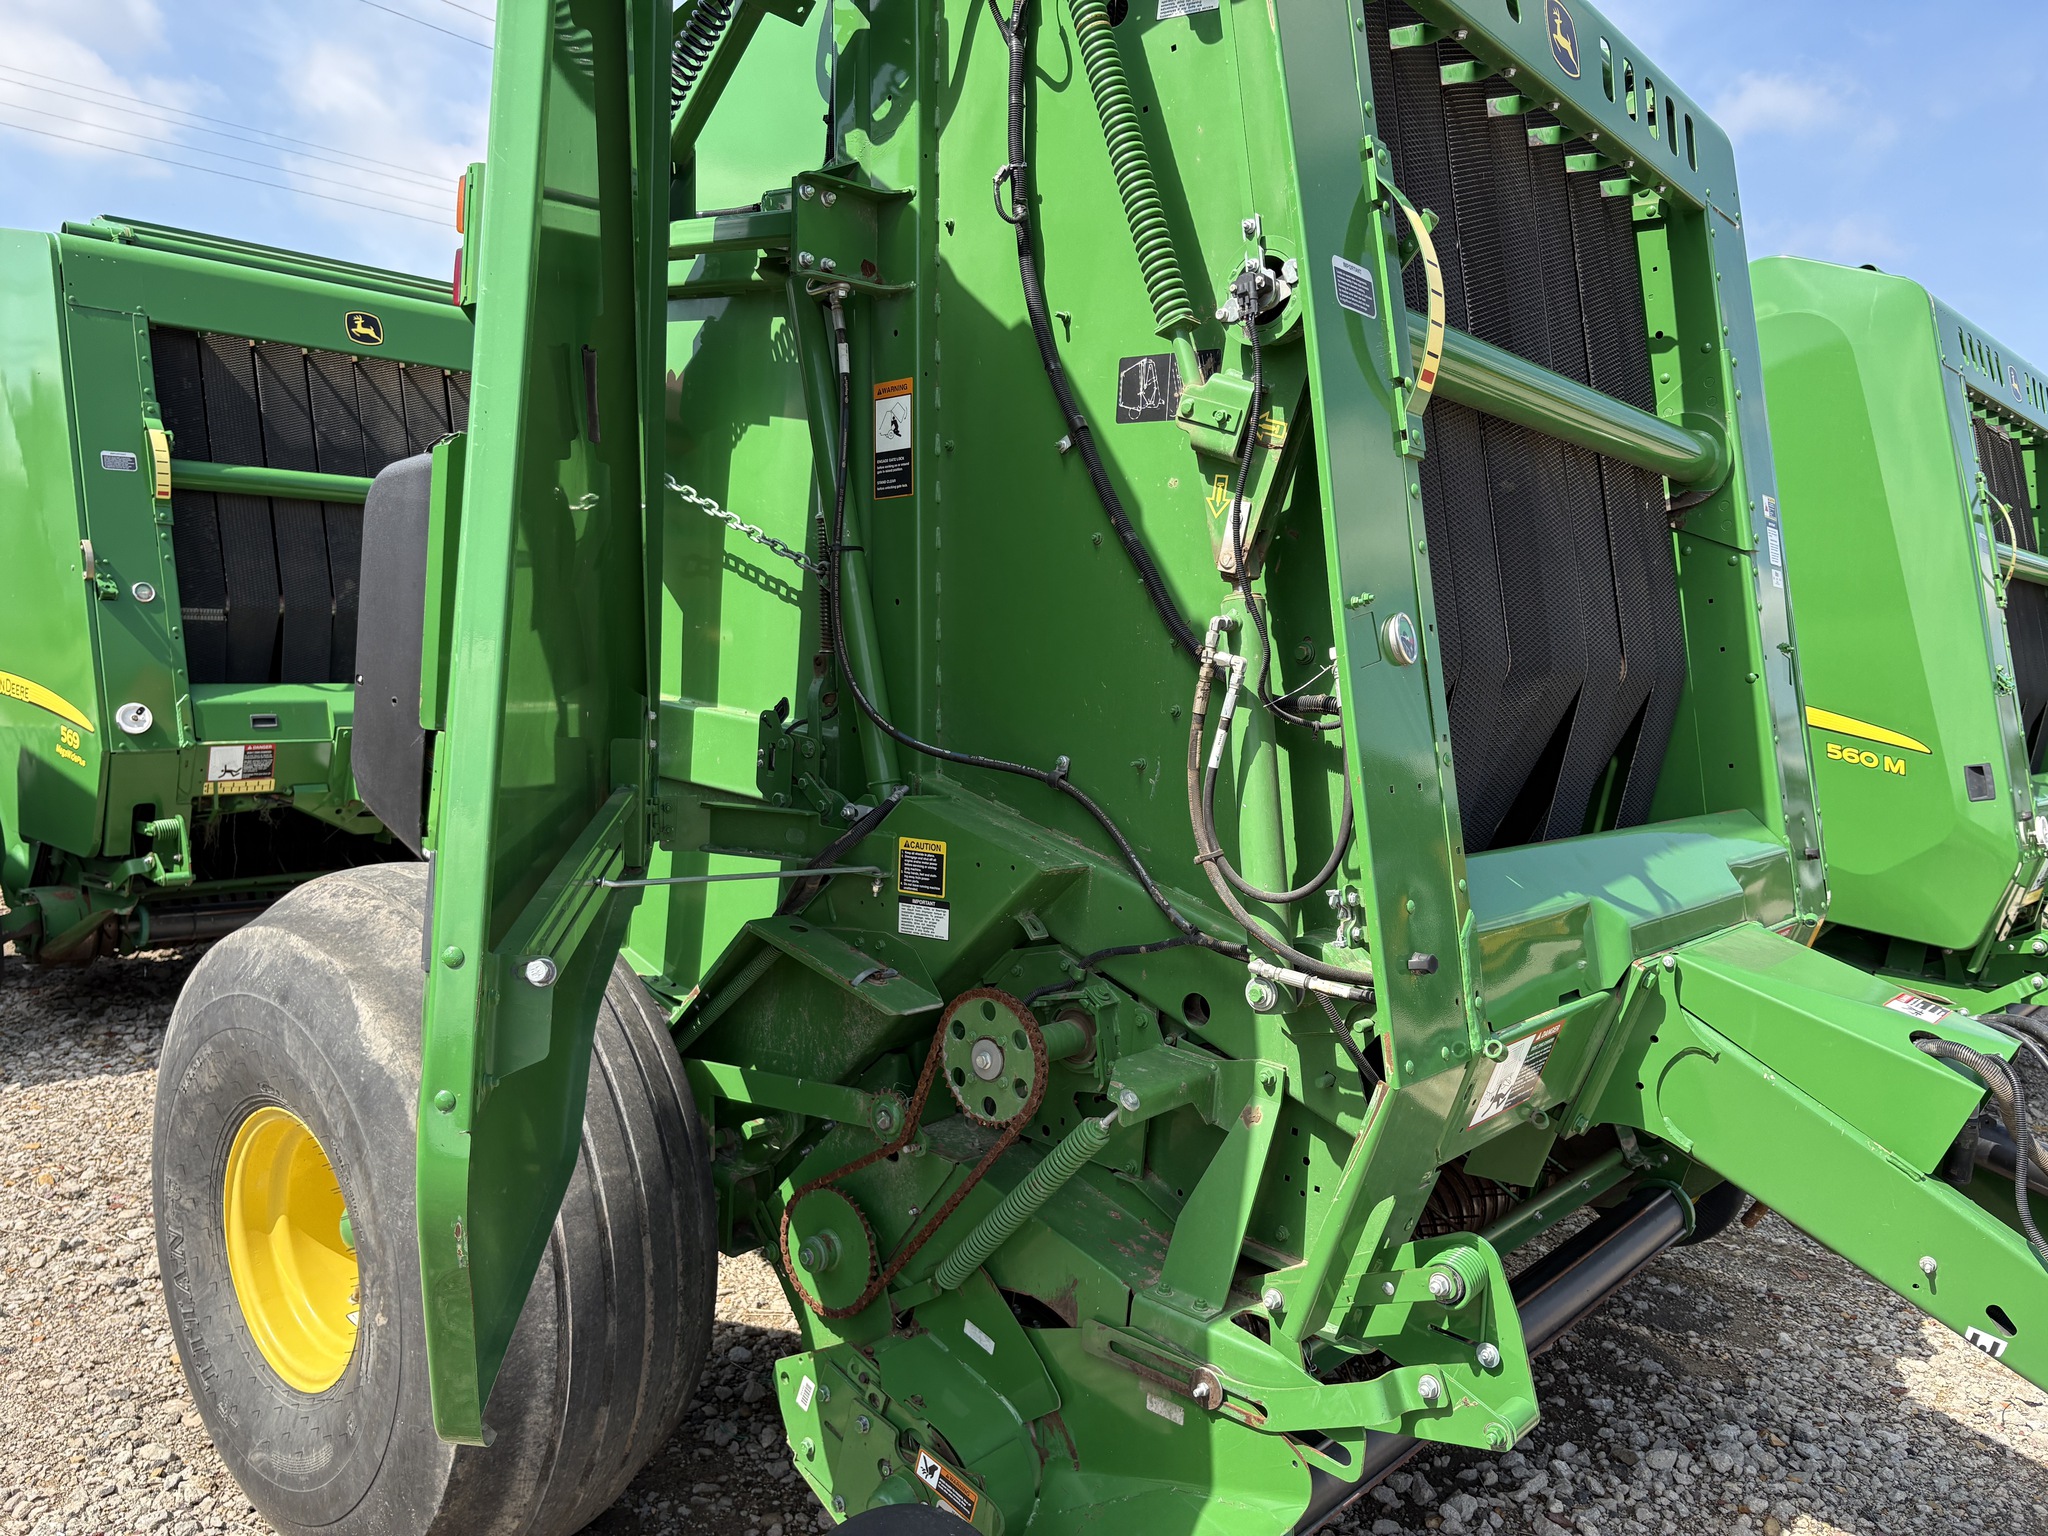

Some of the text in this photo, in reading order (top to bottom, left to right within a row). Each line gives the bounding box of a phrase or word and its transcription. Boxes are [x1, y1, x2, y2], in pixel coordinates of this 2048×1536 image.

[881, 383, 908, 394] WARNING
[60, 724, 80, 750] 569
[1826, 742, 1906, 776] 560 M
[910, 841, 942, 852] CAUTION
[912, 898, 936, 906] IMPORTANT
[1541, 1024, 1562, 1039] DANGER
